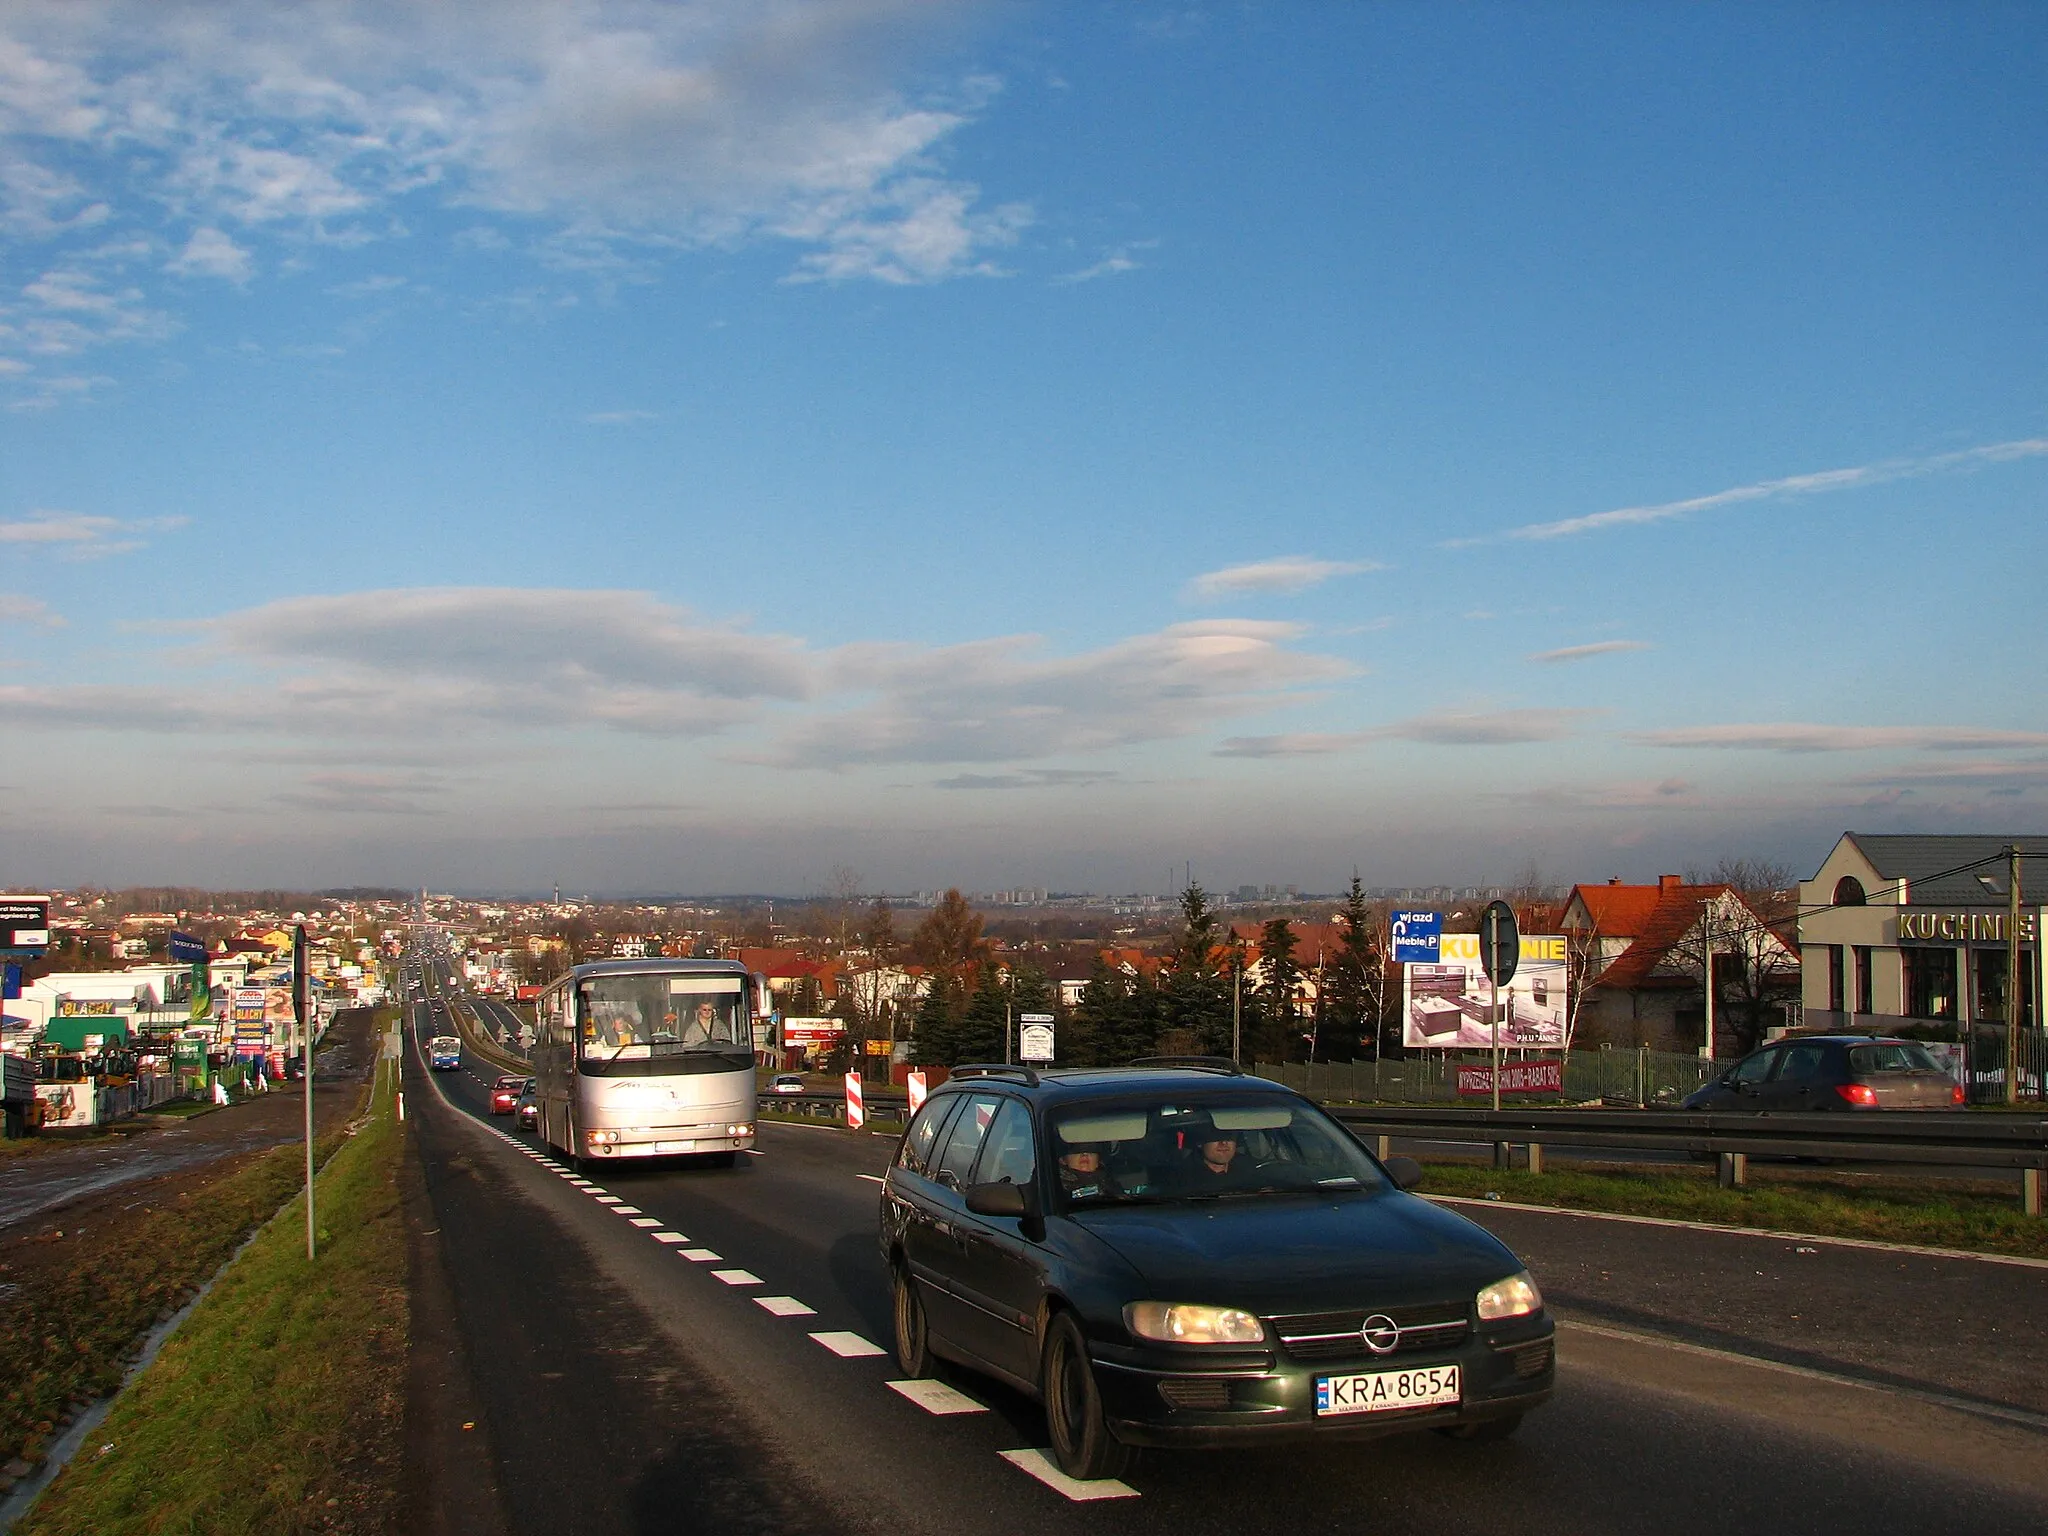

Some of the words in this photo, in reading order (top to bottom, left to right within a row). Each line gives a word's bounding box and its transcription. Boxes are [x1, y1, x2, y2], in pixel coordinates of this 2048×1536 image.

[1897, 914, 2033, 941] KUCHNIE
[174, 940, 204, 950] VOLVO
[1397, 936, 1425, 946] Meble
[1441, 939, 1565, 960] KUNIE
[63, 1001, 114, 1016] BLACHY
[1333, 1375, 1387, 1405] KRA
[1398, 1367, 1457, 1399] 8G54
